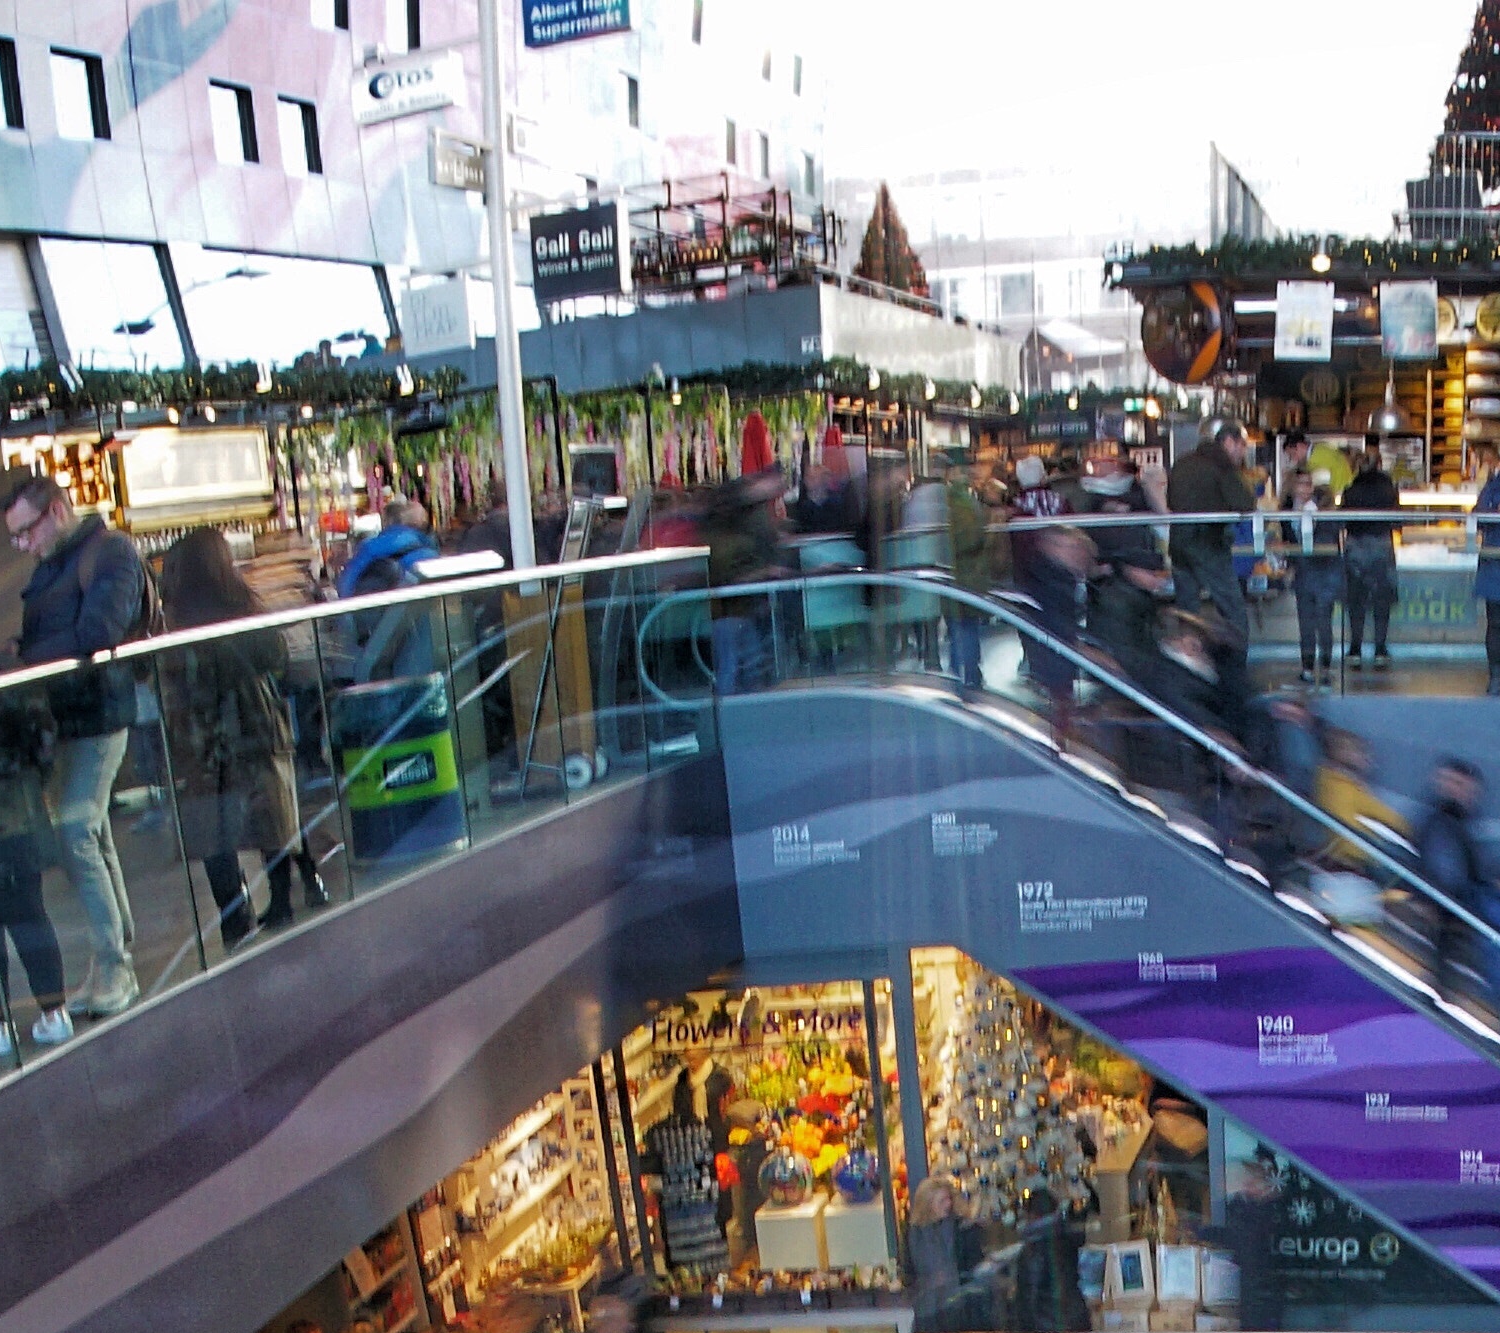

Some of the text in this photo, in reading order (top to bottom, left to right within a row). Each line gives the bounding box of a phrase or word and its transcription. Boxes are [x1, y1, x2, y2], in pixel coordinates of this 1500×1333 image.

[531, 1, 578, 23] Albert
[535, 231, 570, 260] Gall
[578, 228, 614, 252] Gall
[772, 823, 810, 844] 2014
[763, 1010, 781, 1034] &
[796, 1005, 862, 1033] More
[1257, 1014, 1294, 1035] 1940
